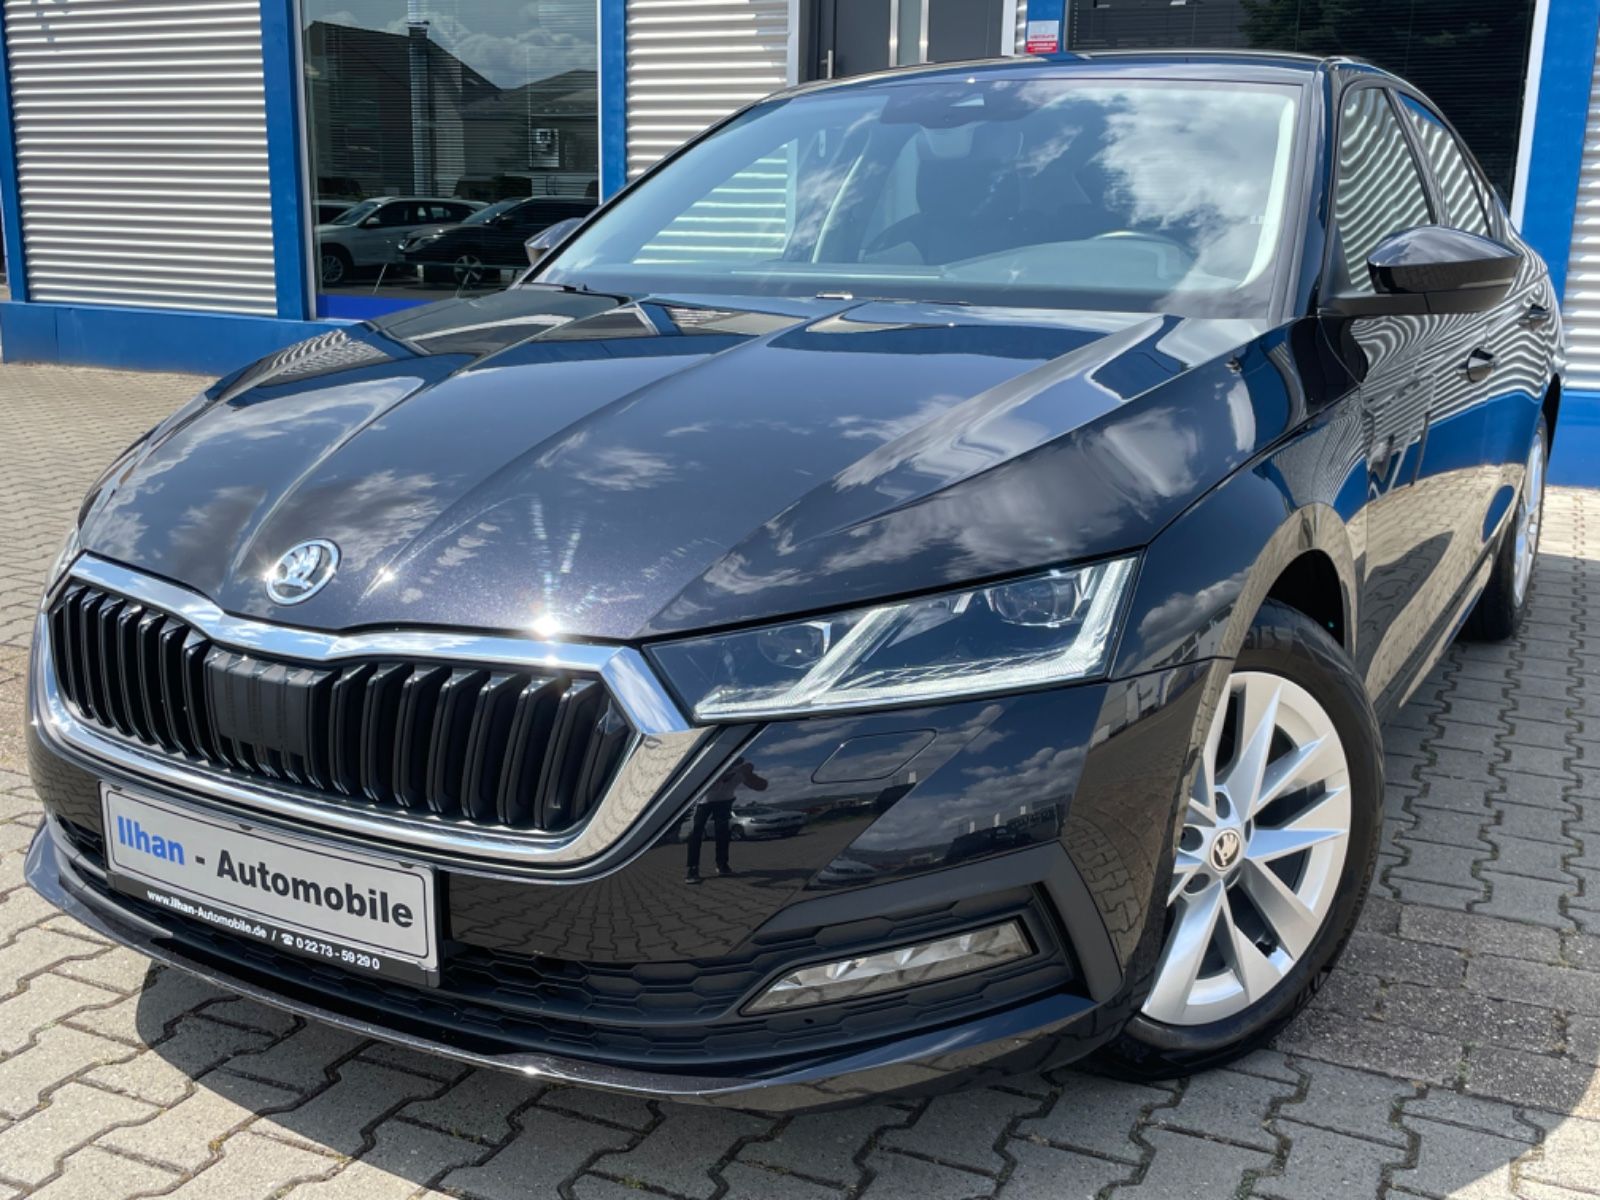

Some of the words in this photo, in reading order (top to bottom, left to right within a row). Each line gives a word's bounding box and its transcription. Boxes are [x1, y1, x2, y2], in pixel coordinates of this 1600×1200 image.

[117, 815, 185, 866] Ilhan
[195, 855, 206, 865] -
[216, 849, 414, 928] Automobile
